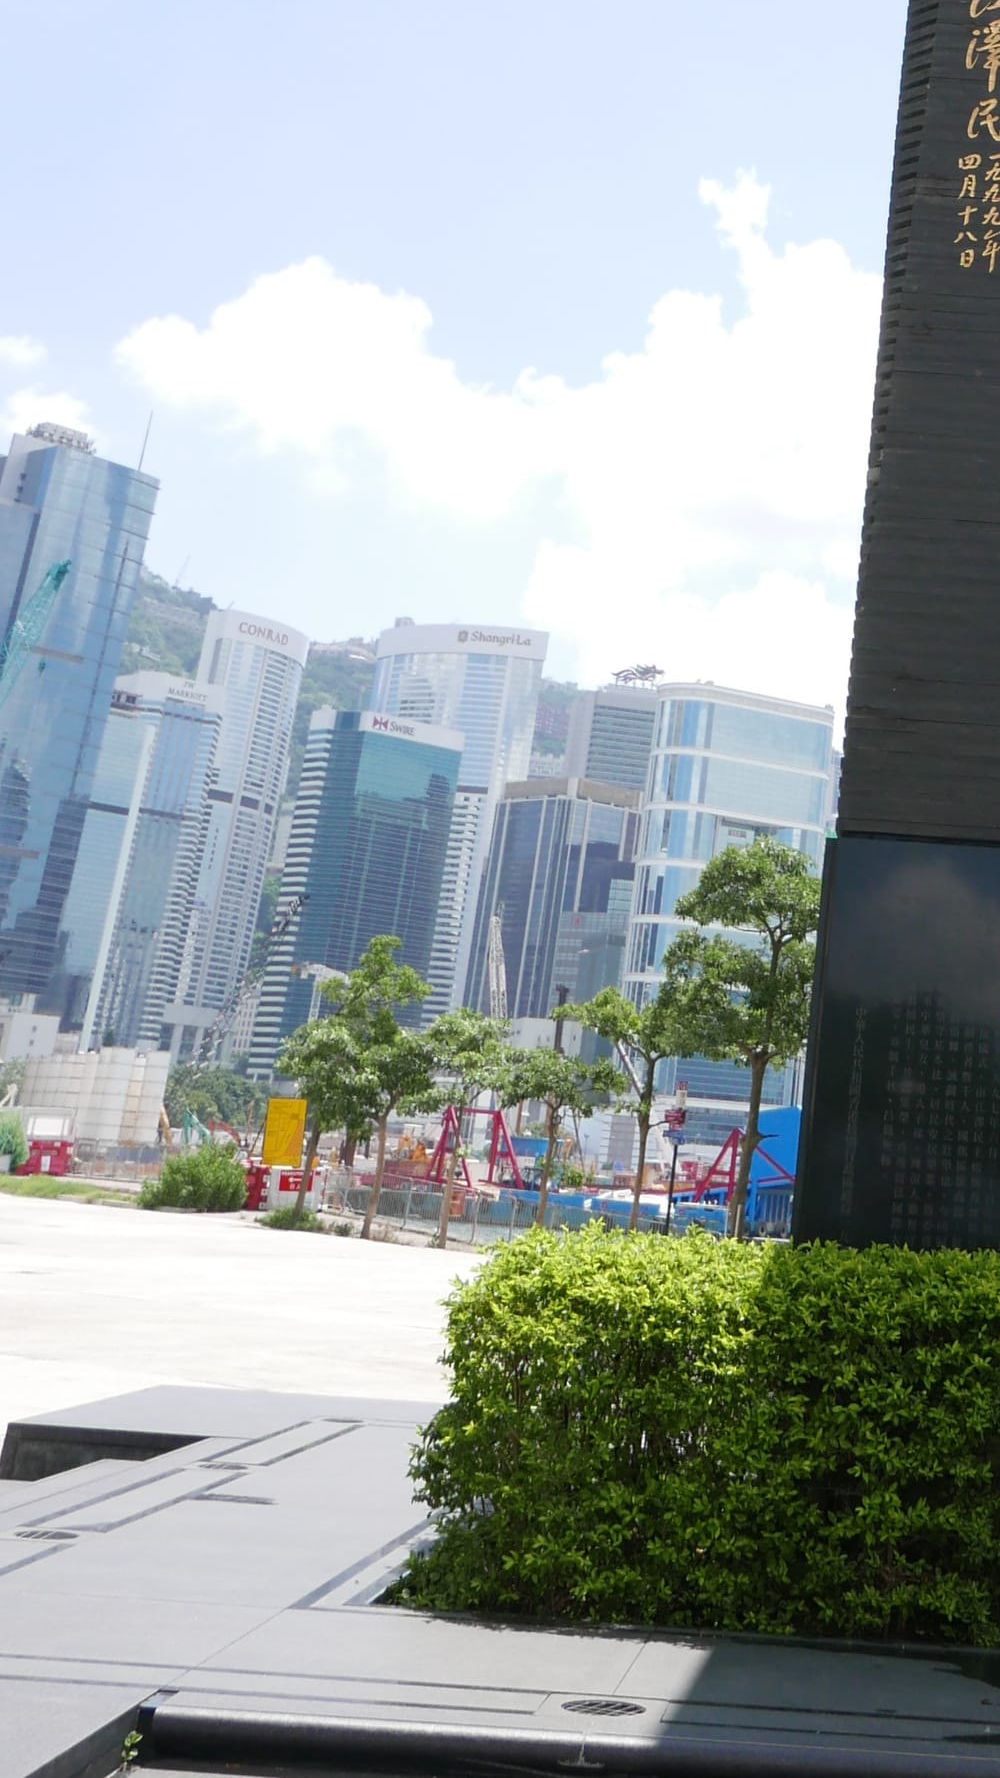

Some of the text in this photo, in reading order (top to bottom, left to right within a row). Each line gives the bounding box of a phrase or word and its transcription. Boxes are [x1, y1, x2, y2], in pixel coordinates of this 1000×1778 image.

[953, 152, 984, 269] 四月十八日
[238, 621, 289, 646] CONRAD
[167, 686, 208, 702] MARRIOTT
[389, 721, 416, 737] SWIRE
